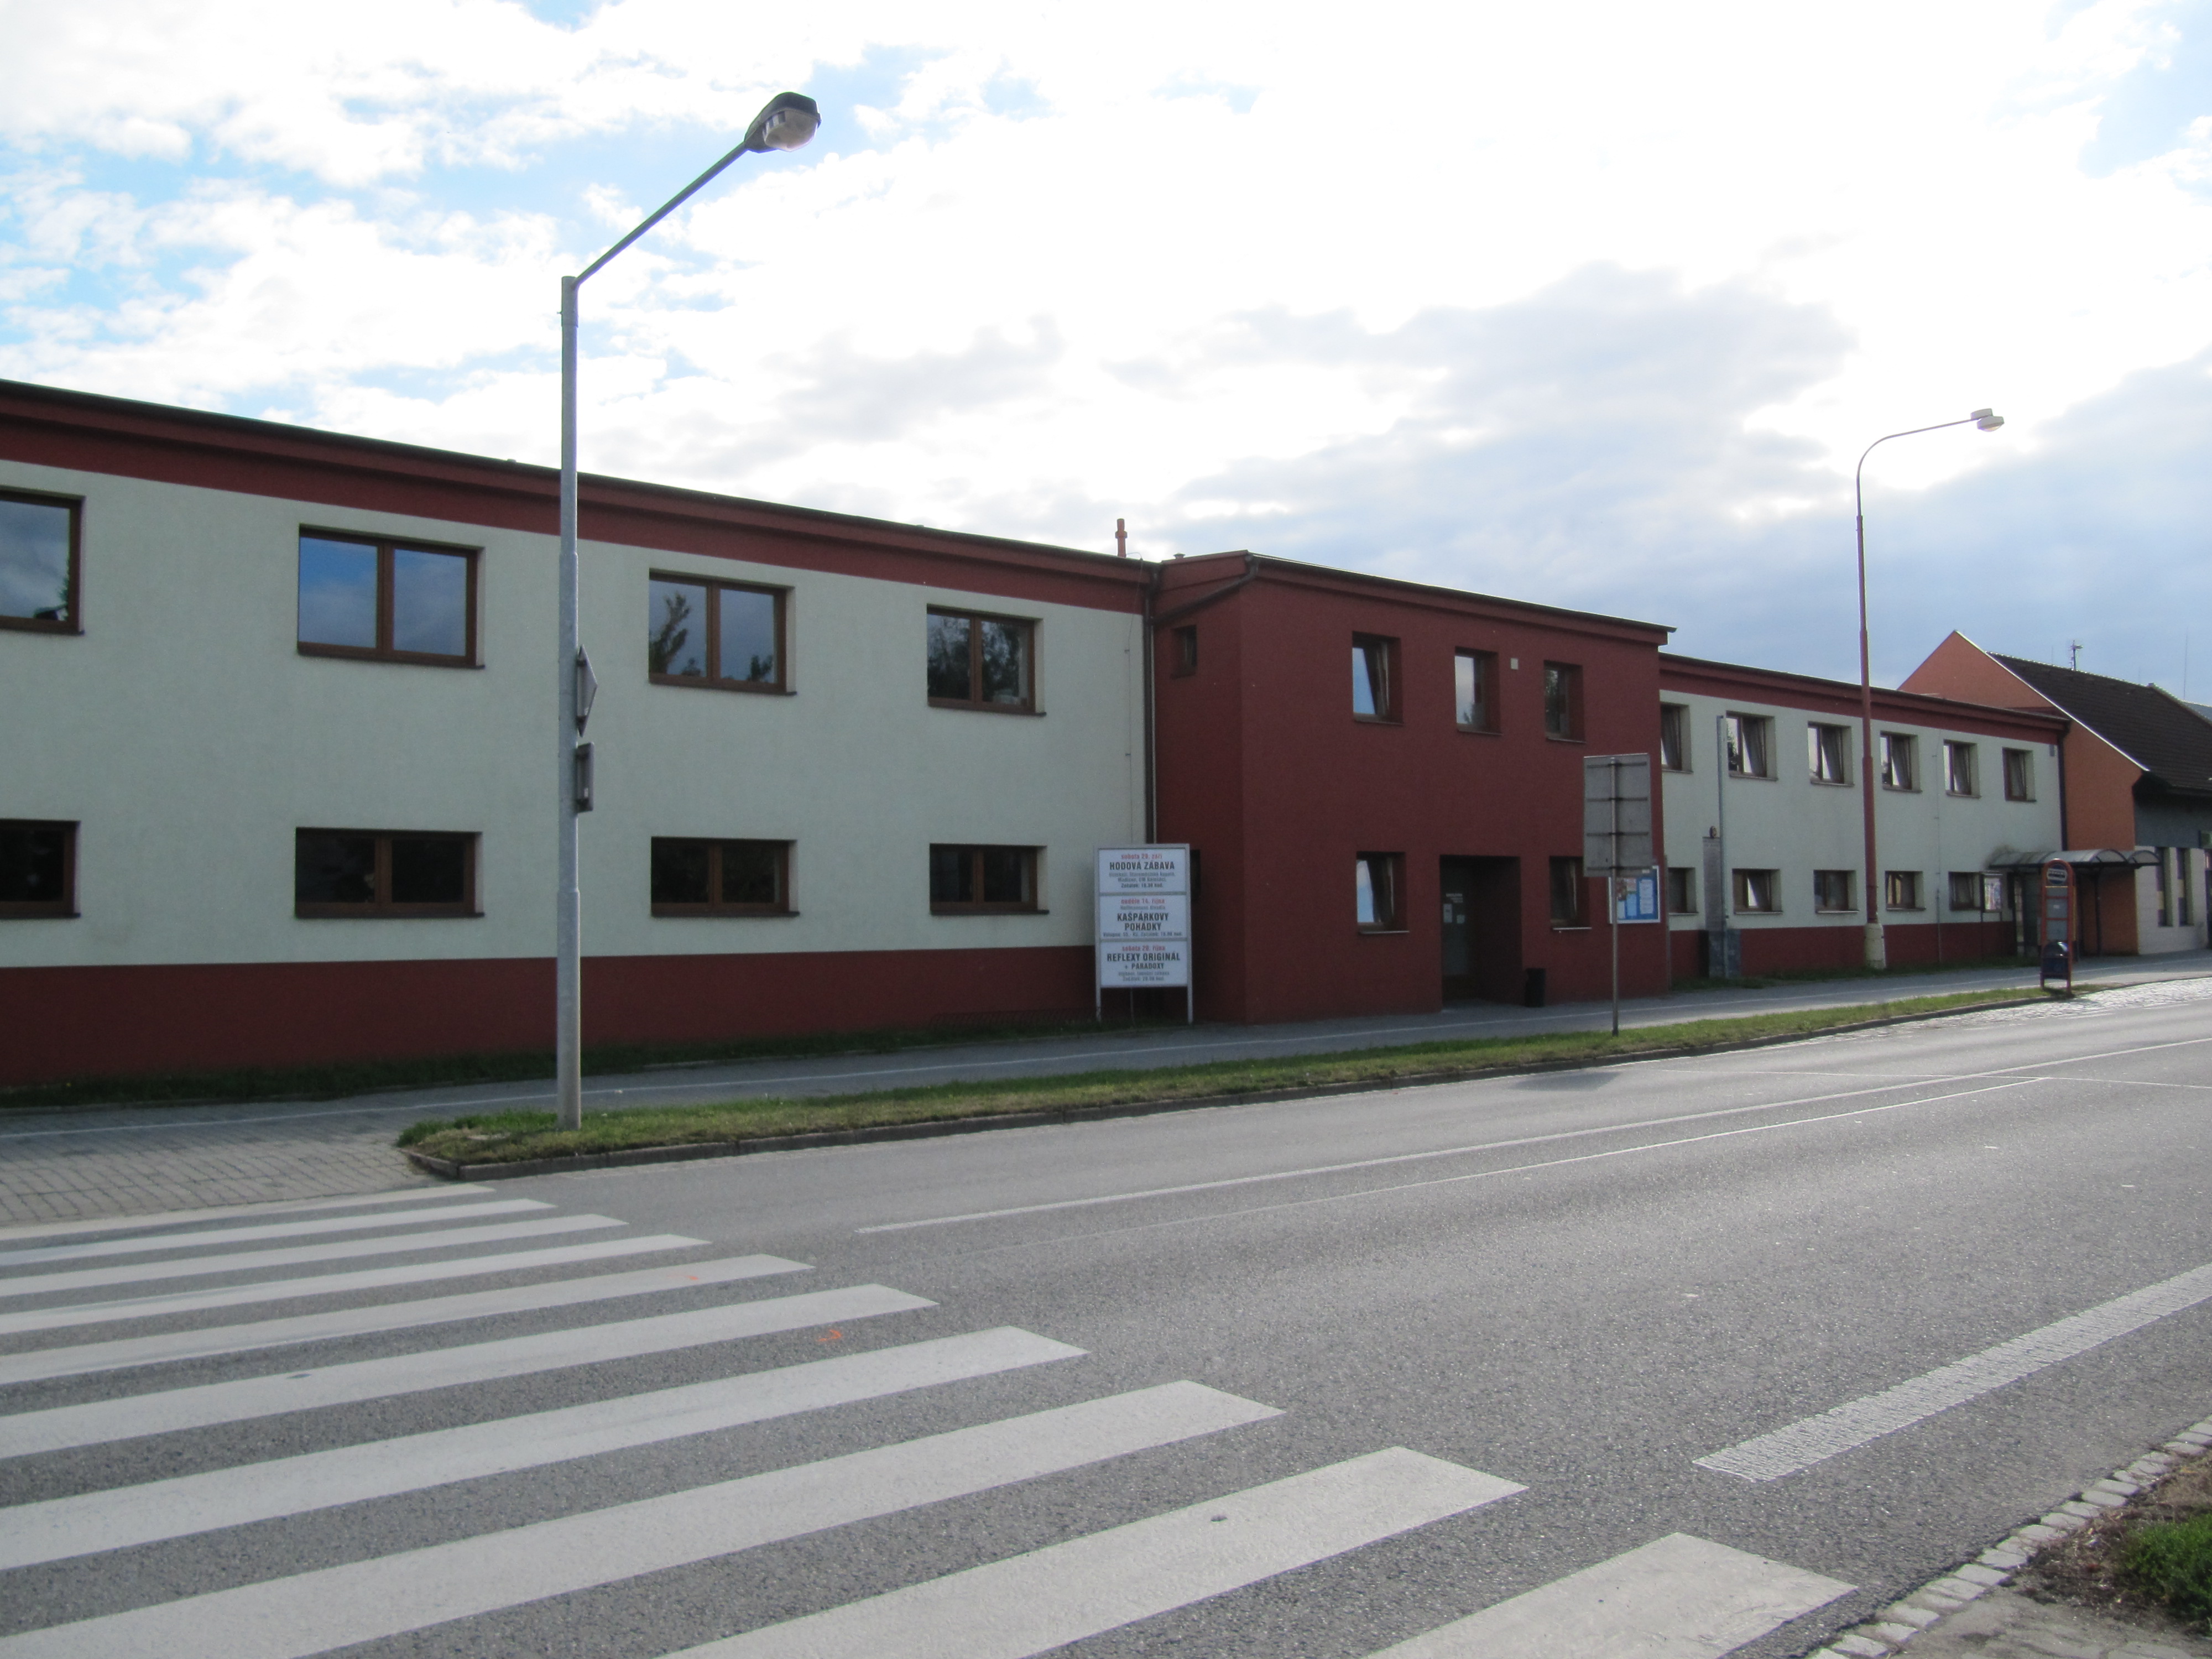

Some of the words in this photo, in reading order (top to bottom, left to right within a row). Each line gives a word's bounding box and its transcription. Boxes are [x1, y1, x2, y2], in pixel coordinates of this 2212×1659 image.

[1109, 860, 1141, 870] HODOVÁ
[1144, 860, 1175, 869] ZÁBAVA
[1117, 912, 1168, 921] KAŠPÁRKOVY
[1124, 921, 1161, 931] POHÁDKY
[1107, 953, 1140, 961] REFLEXY
[1143, 951, 1180, 961] ORIGINÁL
